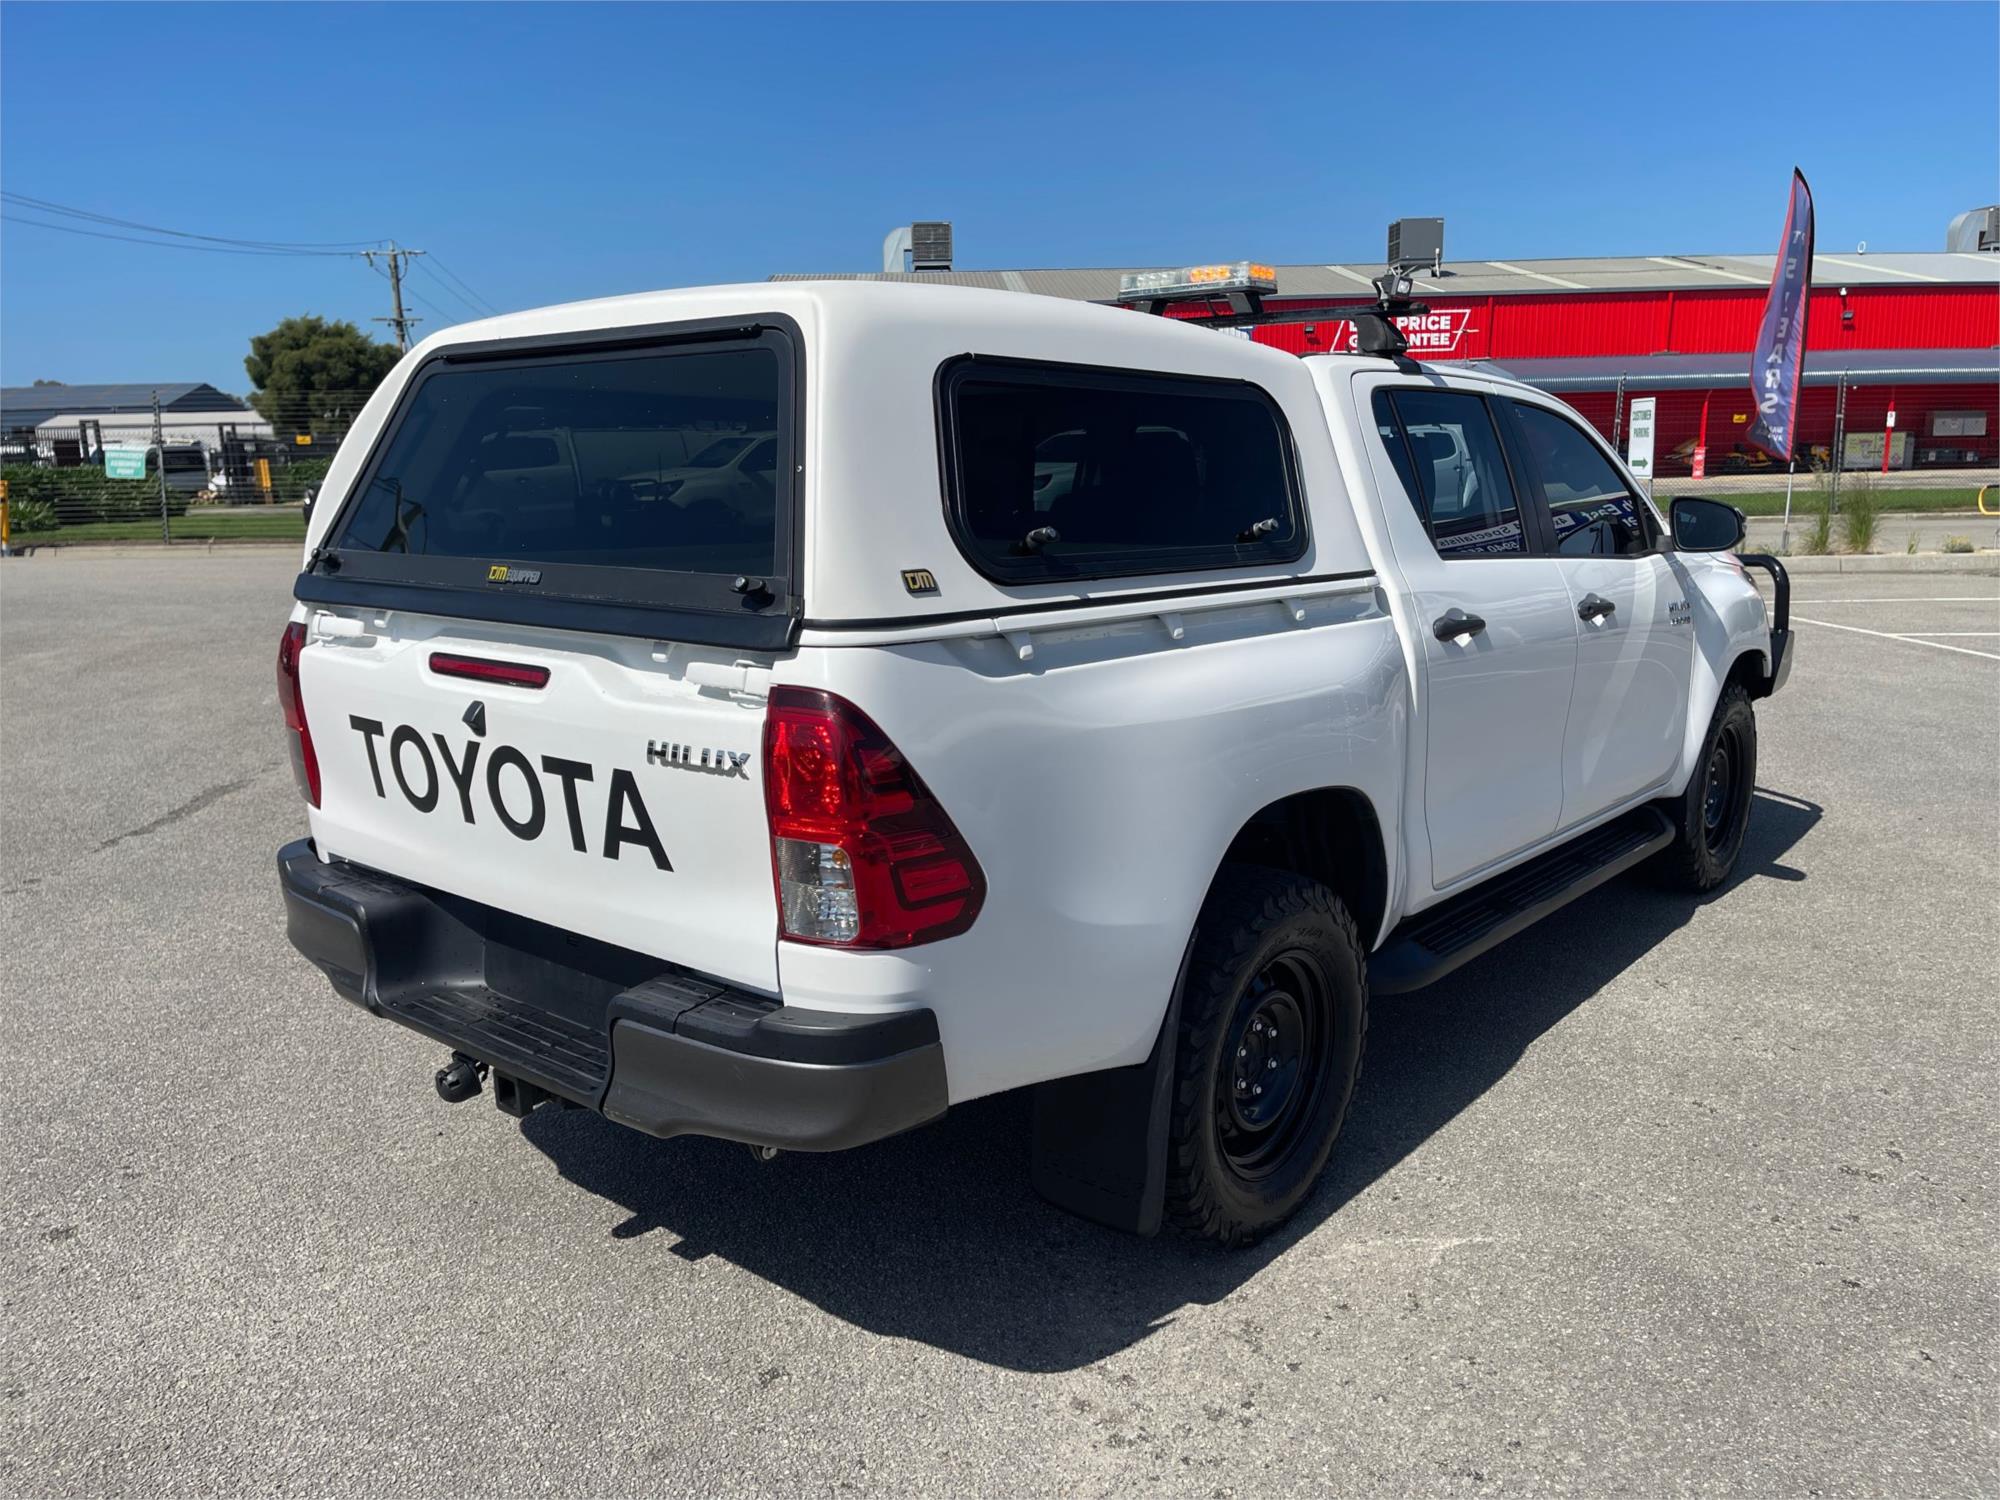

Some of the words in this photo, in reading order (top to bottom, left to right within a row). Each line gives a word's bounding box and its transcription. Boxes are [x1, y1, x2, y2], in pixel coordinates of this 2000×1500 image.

[1396, 315, 1451, 331] PRICE
[646, 739, 751, 780] HILUX
[349, 714, 674, 873] TOYOTA
